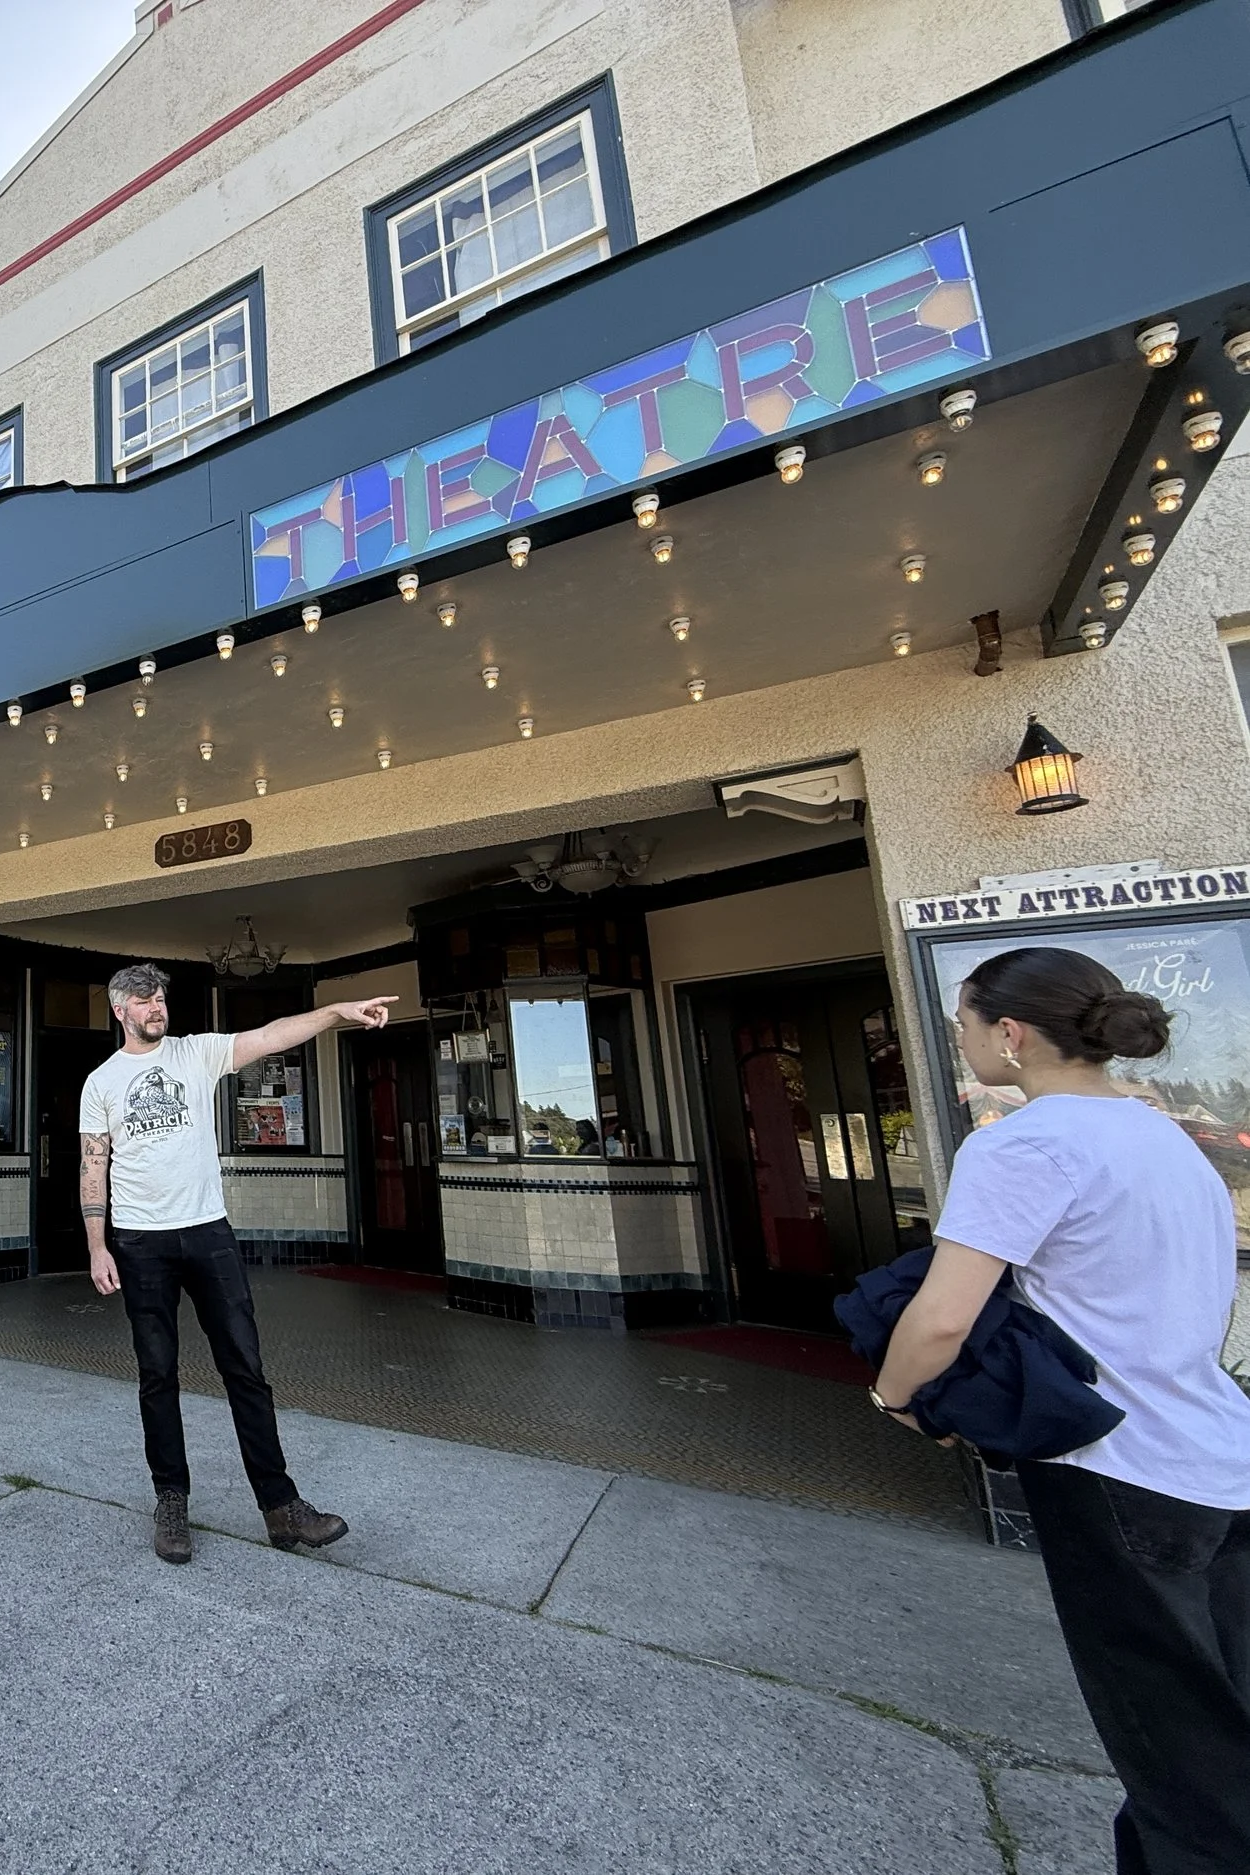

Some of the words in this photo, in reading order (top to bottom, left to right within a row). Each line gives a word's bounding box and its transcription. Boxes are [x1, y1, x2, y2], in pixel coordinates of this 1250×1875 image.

[265, 267, 954, 579] THEATRE
[161, 822, 241, 862] 5848
[916, 895, 1002, 924] NEXT
[1017, 871, 1248, 915] ATTRACTION
[1125, 940, 1168, 952] JESSICA
[1152, 953, 1214, 1000] Girl
[122, 1110, 193, 1140] PATRICIA
[142, 1128, 175, 1137] THEATRE
